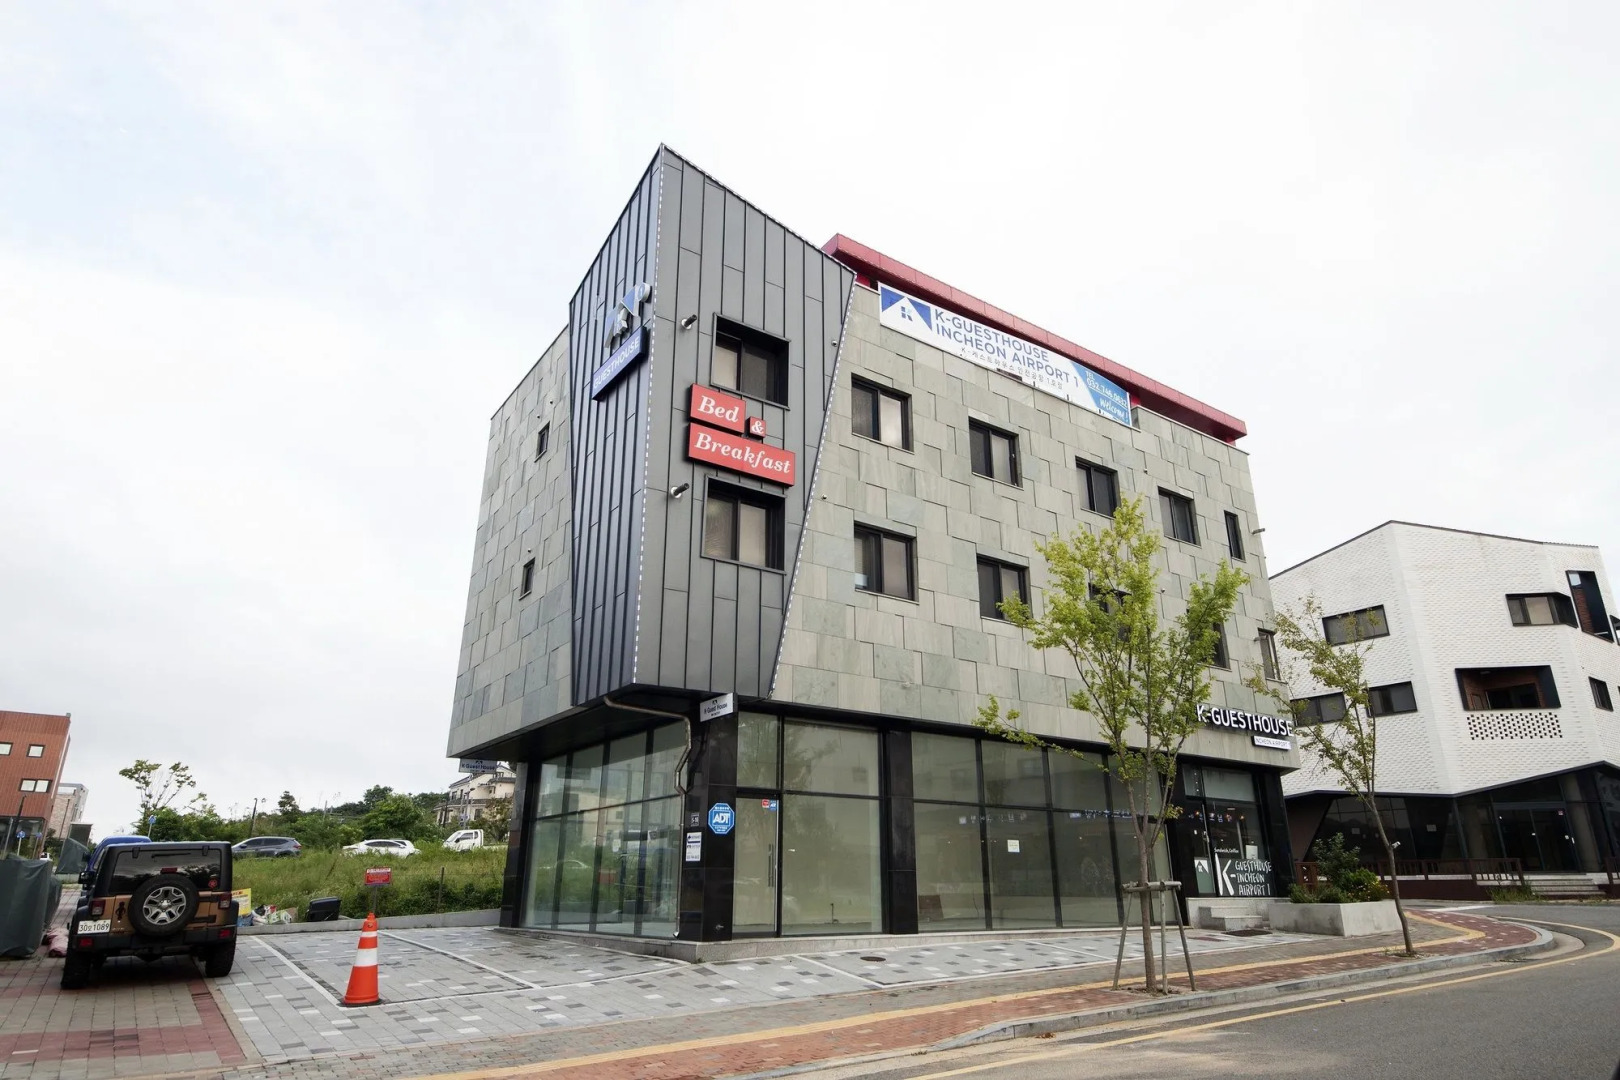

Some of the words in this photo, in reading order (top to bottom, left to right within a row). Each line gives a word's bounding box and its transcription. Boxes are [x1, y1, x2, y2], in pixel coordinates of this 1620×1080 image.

[934, 309, 1049, 362] K-GUESTHOUSE
[593, 336, 640, 389] GUESTHOUSE
[937, 323, 1007, 357] INCHEON
[1012, 352, 1070, 383] AIRPORT
[1073, 376, 1079, 388] 1
[1085, 370, 1095, 381] TEL
[697, 395, 739, 423] Bed
[751, 420, 764, 435] &
[694, 432, 791, 474] Breakfast
[1196, 704, 1294, 737] K-GUESTHOUSE
[712, 812, 730, 824] ADT
[1235, 859, 1272, 874] GUESTHOUSE
[1237, 873, 1265, 883] INCHEON
